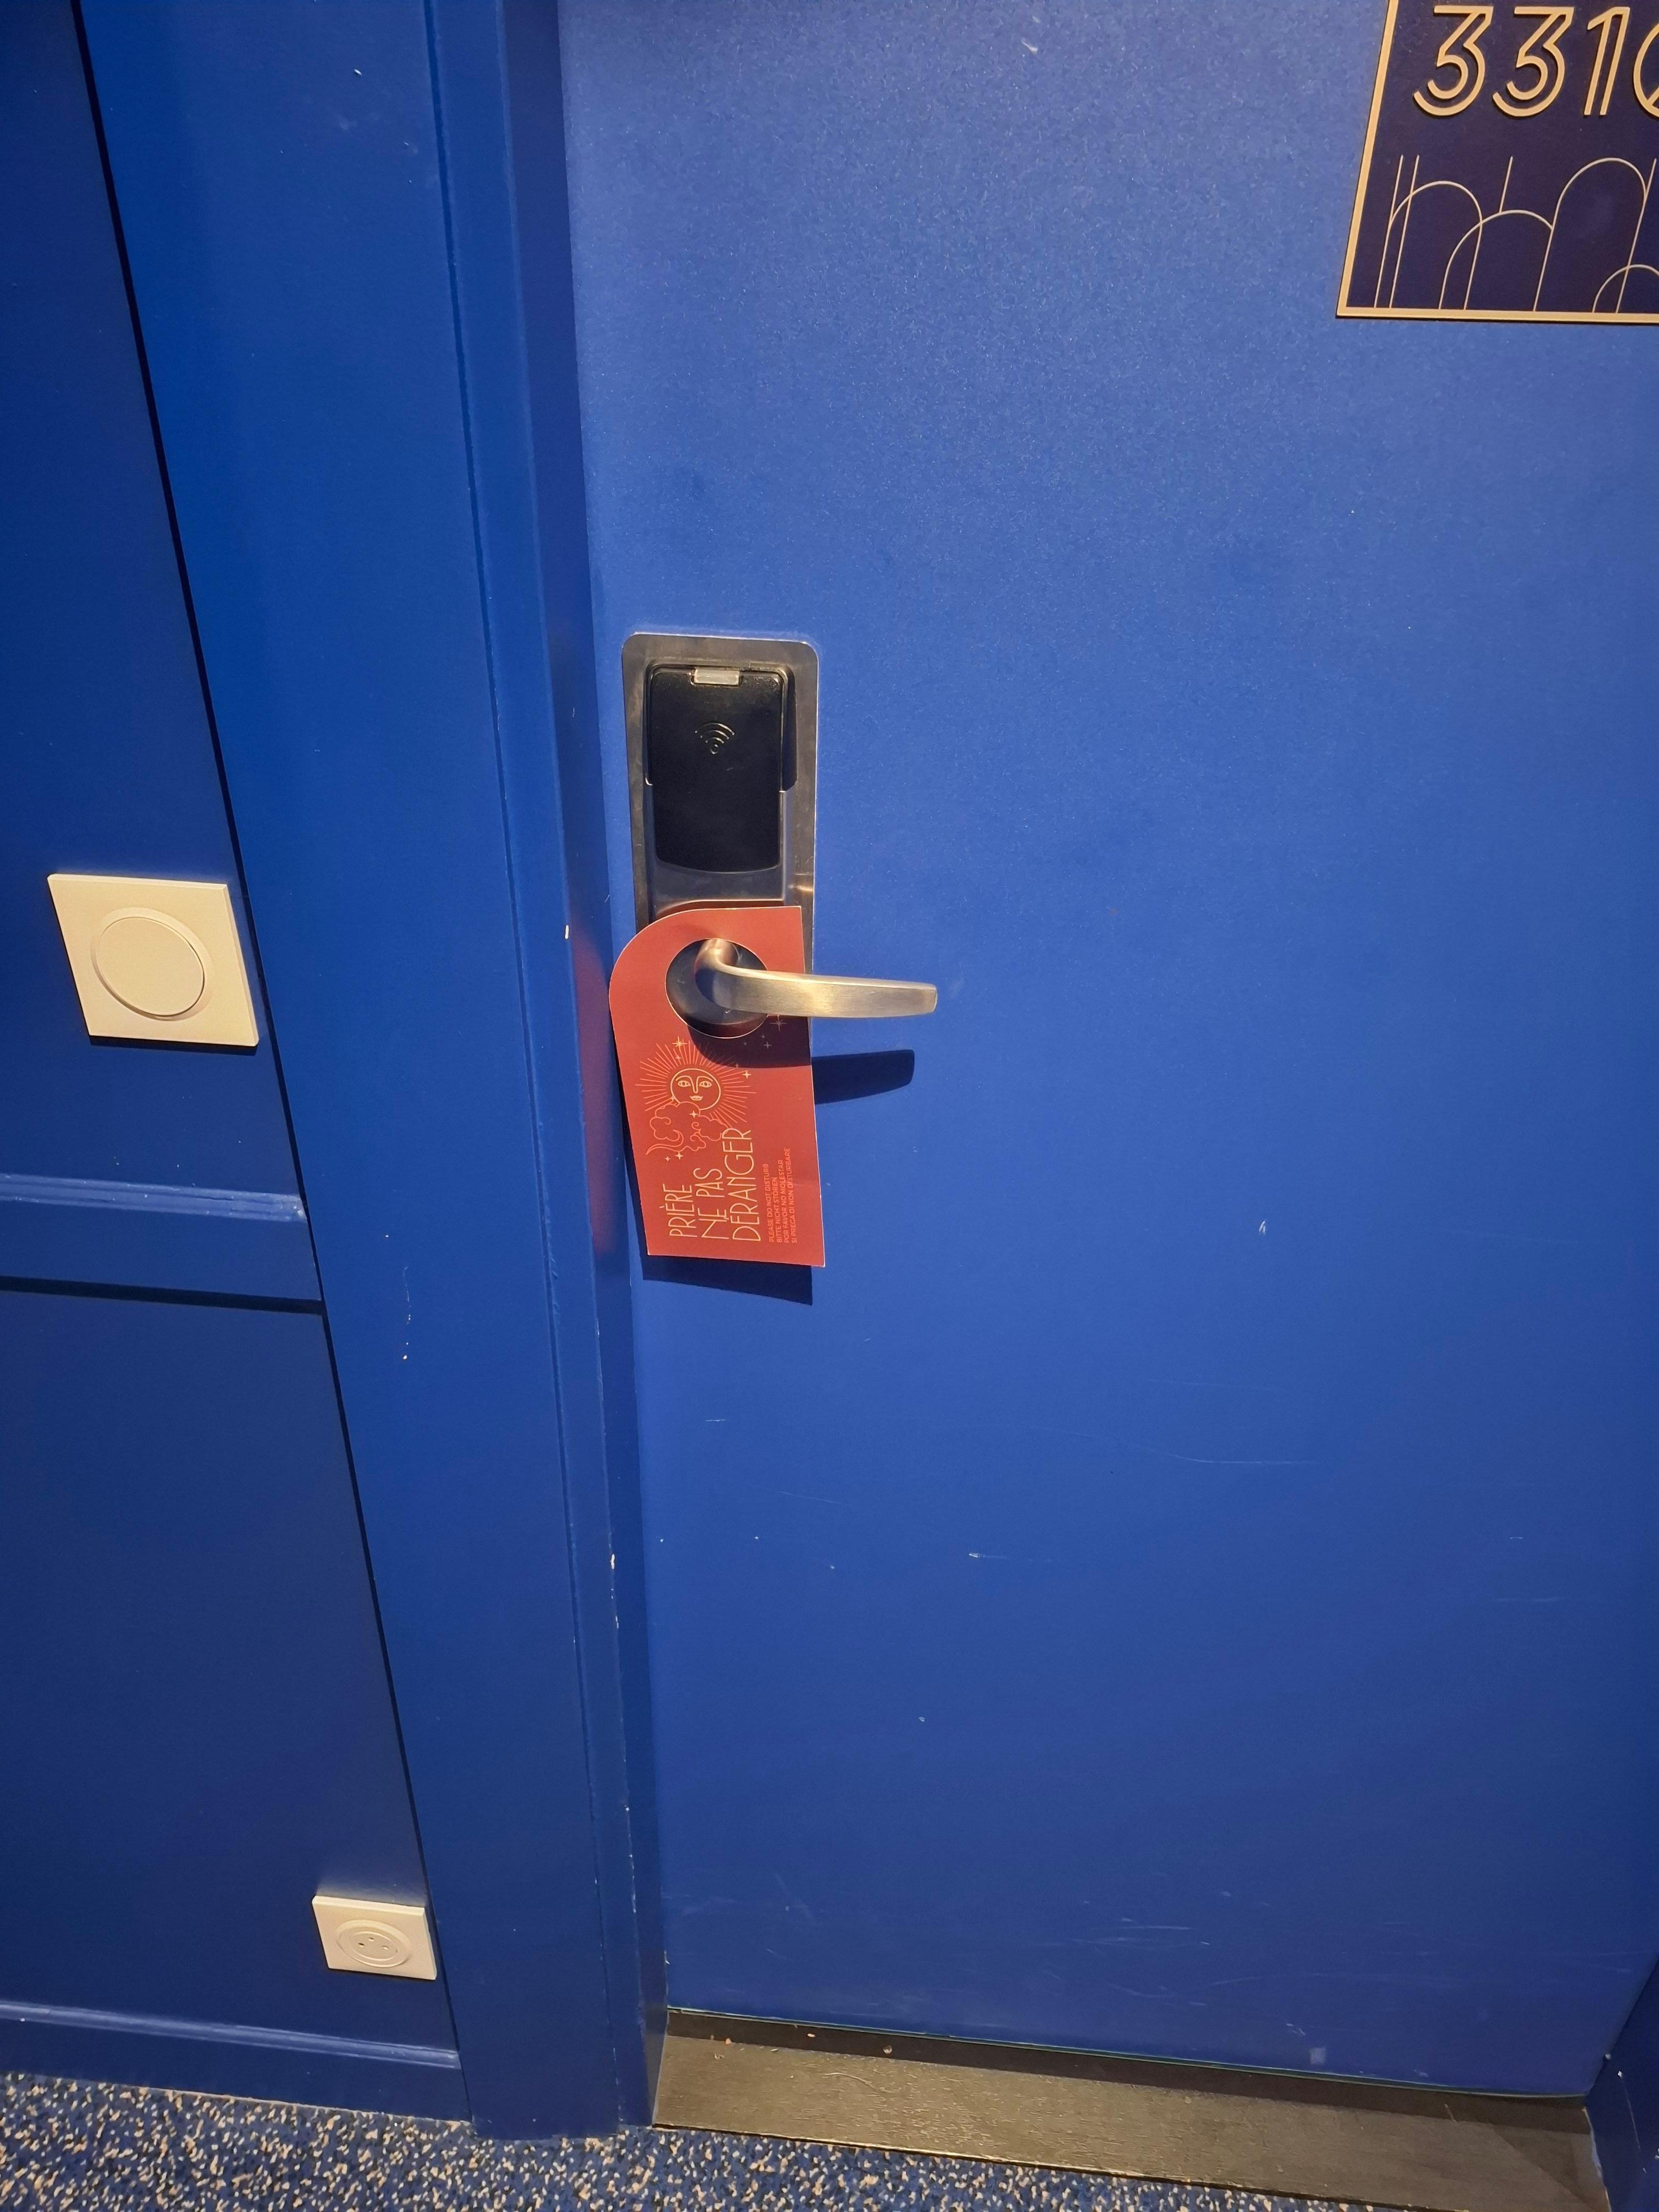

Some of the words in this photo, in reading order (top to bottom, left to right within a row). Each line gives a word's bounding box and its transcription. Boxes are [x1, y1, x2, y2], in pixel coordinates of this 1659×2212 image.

[693, 1168, 725, 1198] PAS
[762, 1163, 770, 1192] DISTURB
[777, 1160, 786, 1194] MOLESTAR
[784, 1147, 794, 1188] DISTURBARE
[722, 1128, 761, 1242] DÉRANGER
[781, 1195, 787, 1206] NO
[659, 1183, 698, 1237] PRIÈRE
[697, 1208, 729, 1239] NE
[767, 1207, 773, 1218] DO
